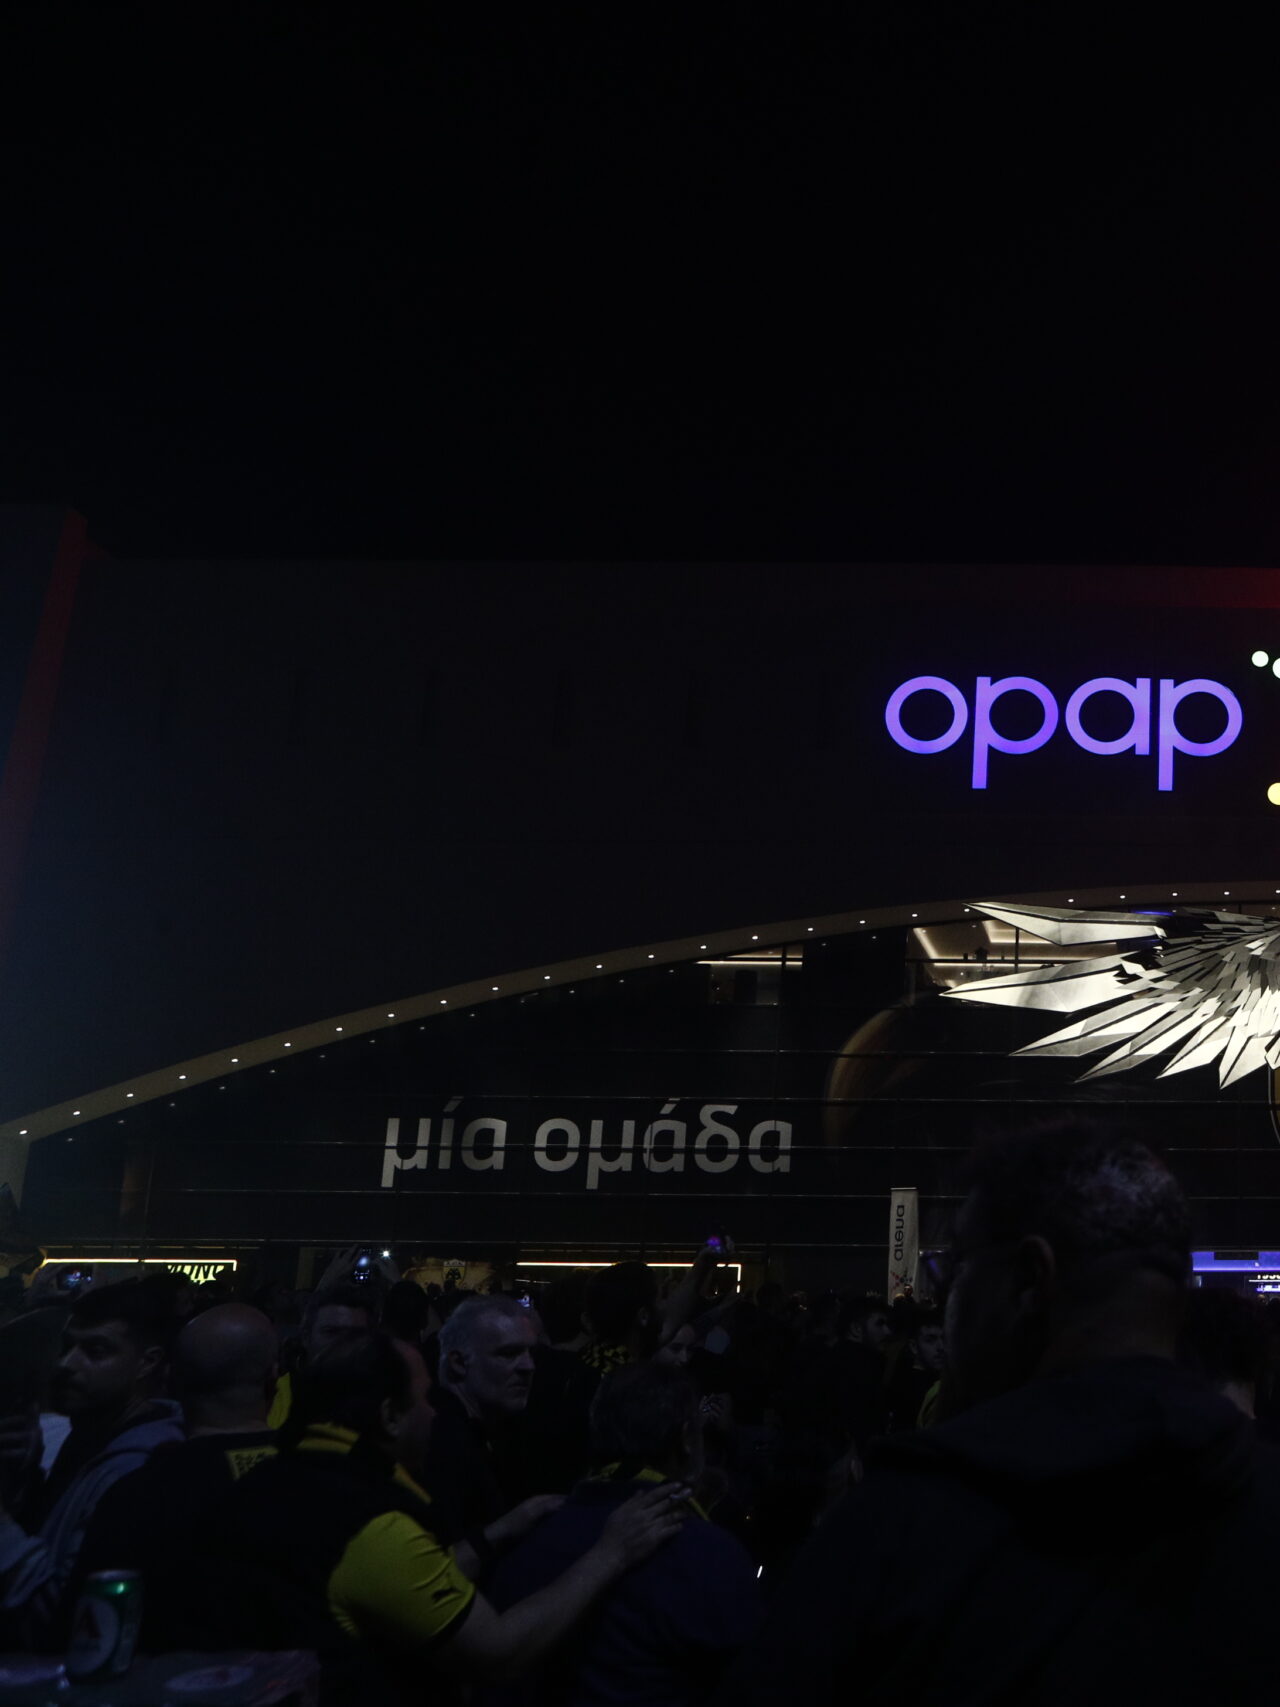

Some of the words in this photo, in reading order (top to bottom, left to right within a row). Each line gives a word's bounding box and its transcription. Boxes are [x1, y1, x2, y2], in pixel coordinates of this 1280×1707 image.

[884, 675, 1244, 792] opap
[380, 1096, 508, 1189] μία
[533, 1098, 793, 1190] ομάδα
[894, 1205, 905, 1261] arena
